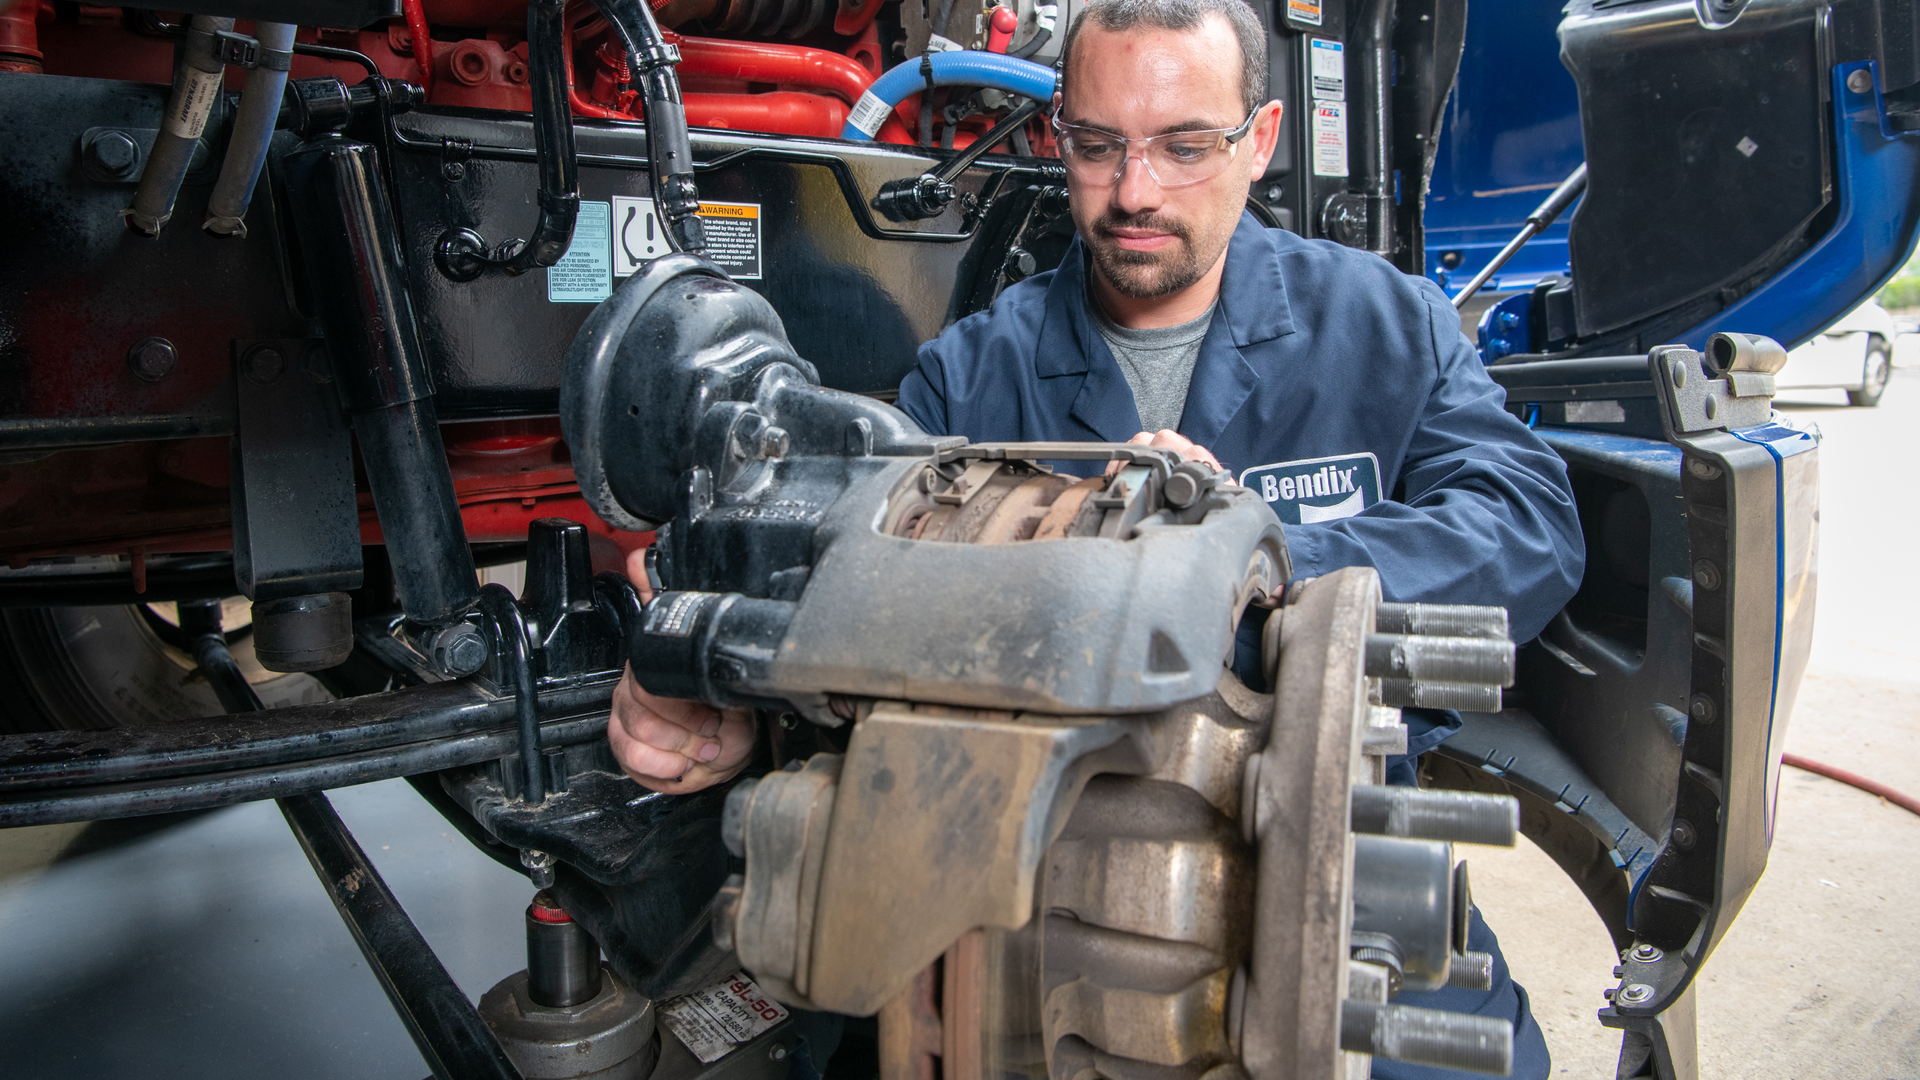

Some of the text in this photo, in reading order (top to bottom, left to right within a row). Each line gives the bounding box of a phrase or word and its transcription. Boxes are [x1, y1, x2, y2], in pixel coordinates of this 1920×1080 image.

[705, 206, 743, 215] WARNING
[1260, 466, 1354, 502] Bendix
[715, 990, 752, 1022] CAPACITY
[721, 1014, 743, 1032] 22,680
